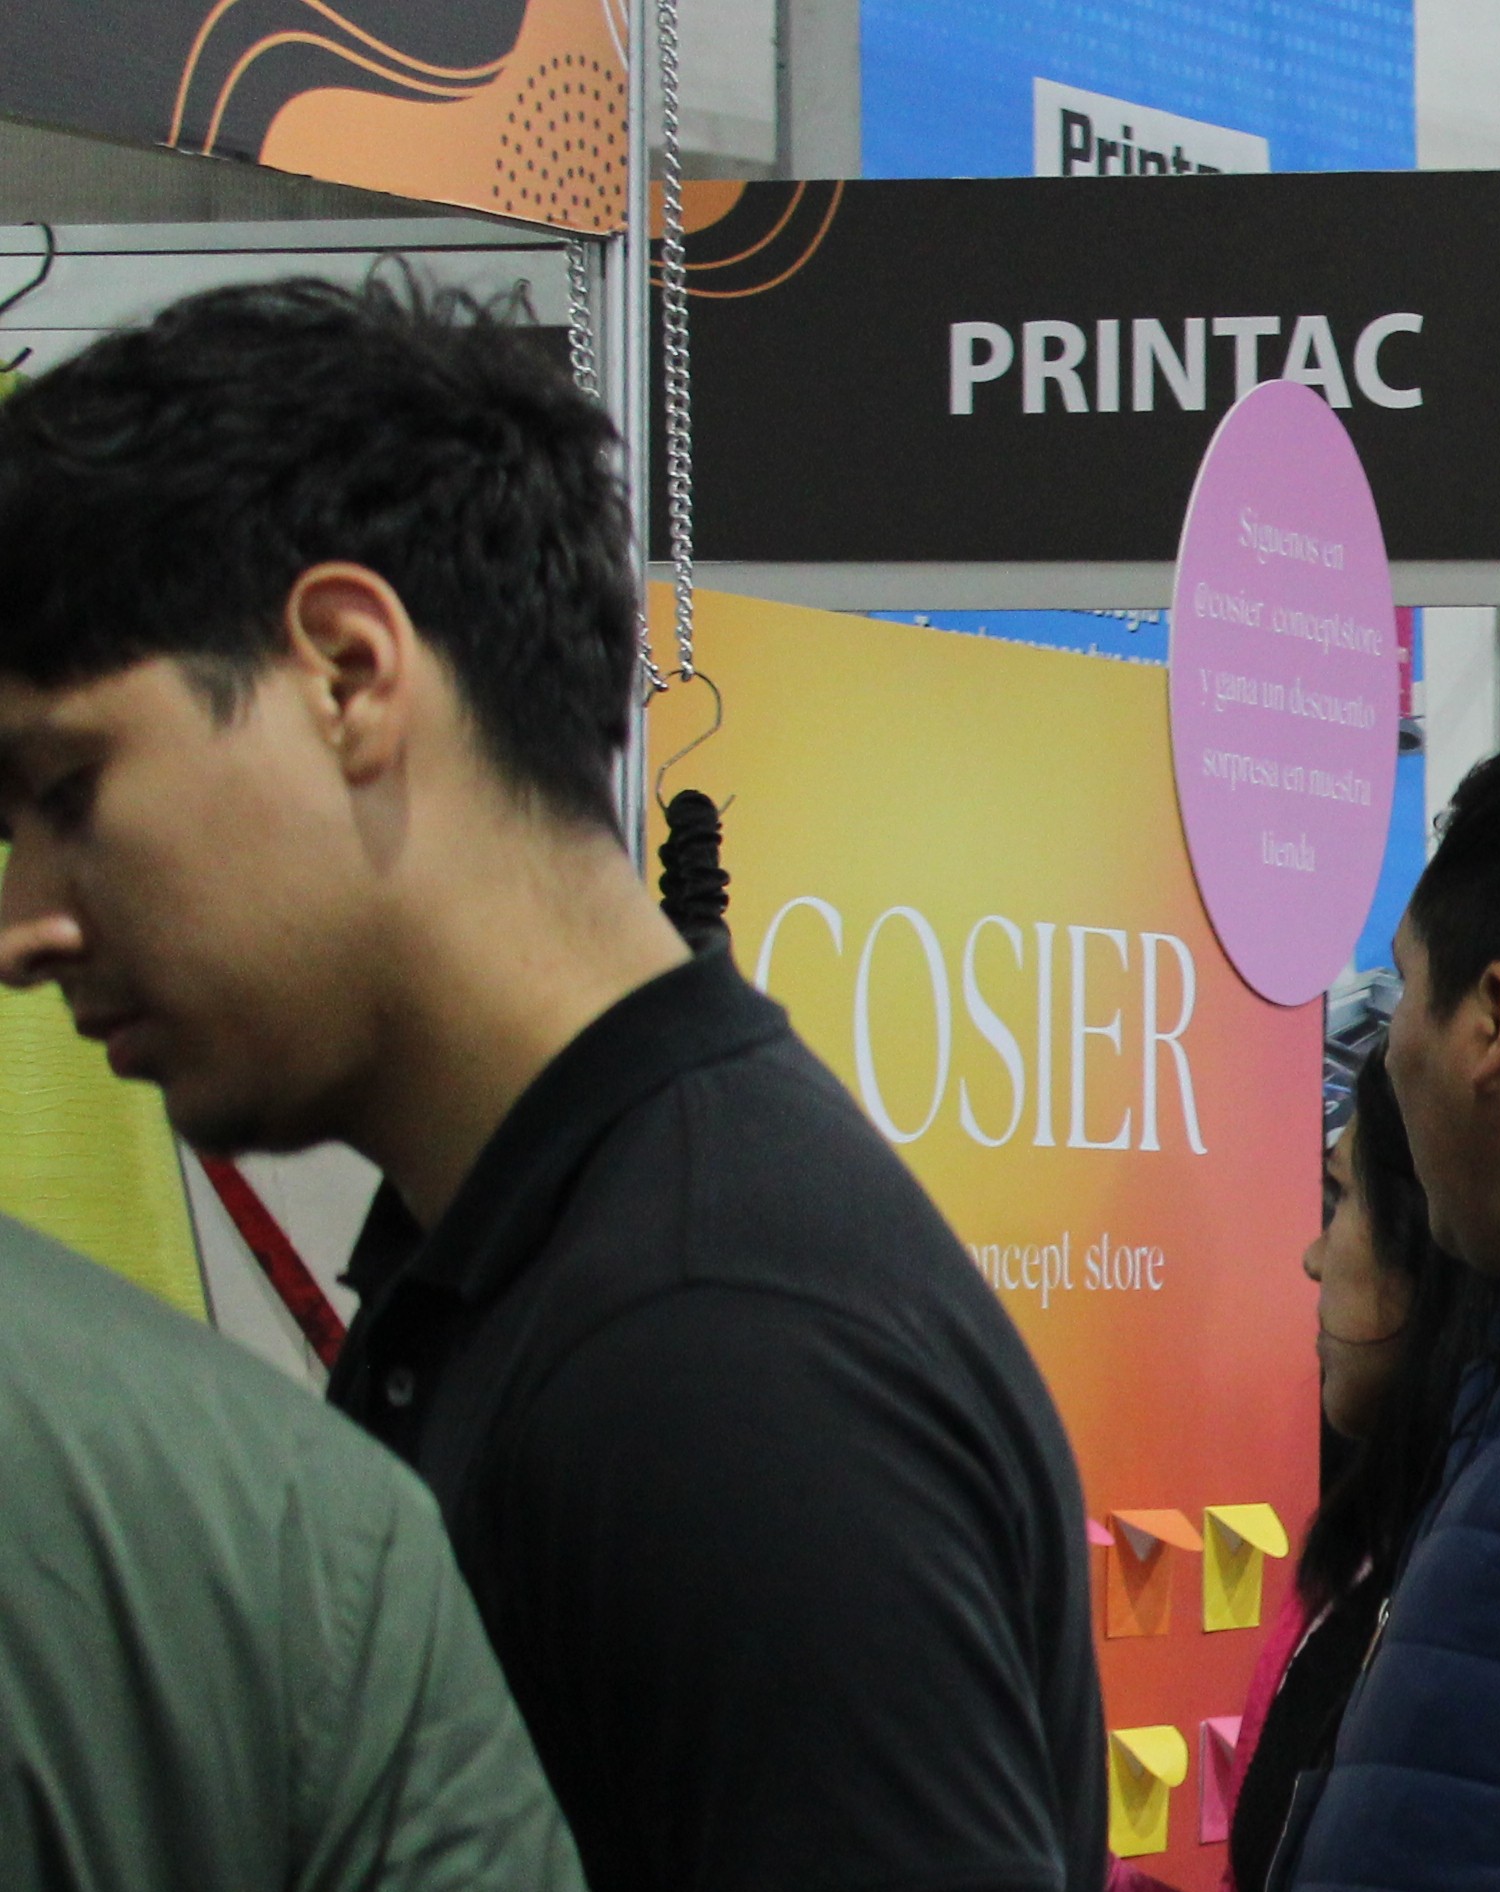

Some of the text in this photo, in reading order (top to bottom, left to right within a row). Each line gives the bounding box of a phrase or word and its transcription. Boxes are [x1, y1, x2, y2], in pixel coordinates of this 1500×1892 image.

[949, 312, 1424, 416] PRINTAC
[1321, 539, 1344, 571] en
[1215, 673, 1259, 713] gana
[1262, 681, 1287, 710] un
[1287, 677, 1376, 731] descuento
[1202, 746, 1371, 807] sorpresa en nuestra
[1261, 831, 1315, 873] tienda
[1084, 1231, 1165, 1293] store
